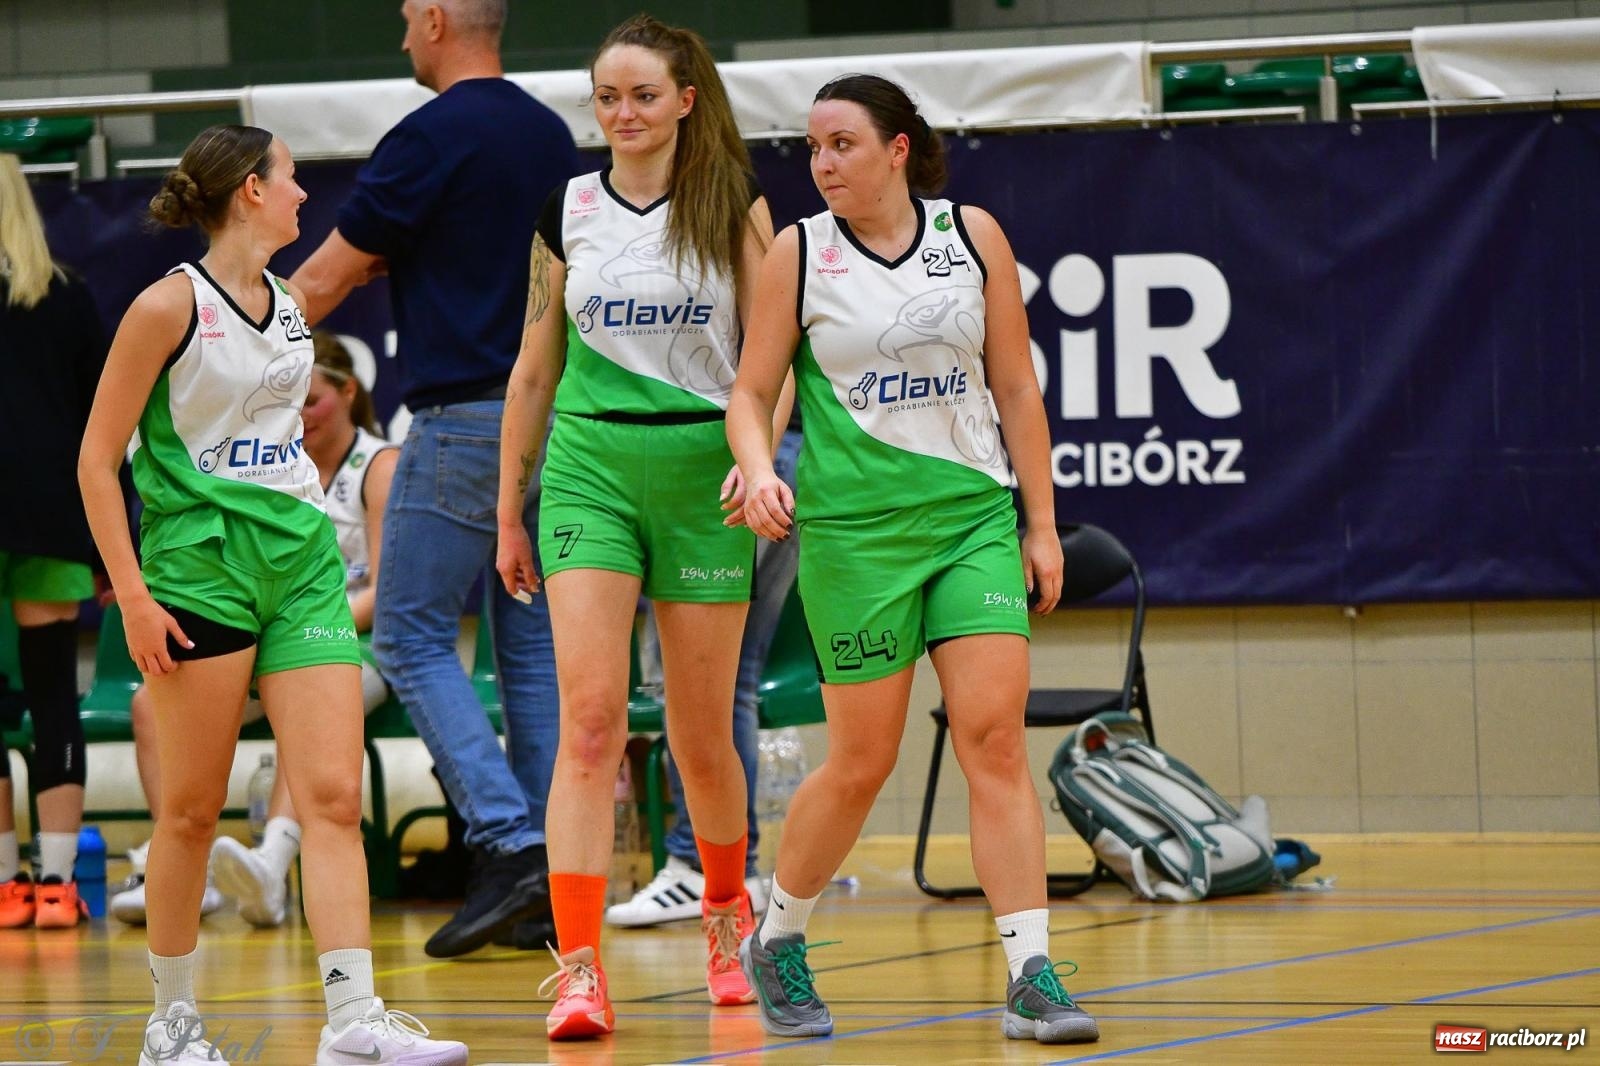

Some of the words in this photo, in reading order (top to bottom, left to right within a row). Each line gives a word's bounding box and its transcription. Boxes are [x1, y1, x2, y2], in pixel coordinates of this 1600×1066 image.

[922, 244, 970, 278] 24
[603, 297, 713, 327] Clavis
[879, 367, 967, 404] Clavis
[888, 400, 941, 413] DORABIANIE
[1051, 425, 1246, 488] CIBÓRZ
[554, 523, 583, 559] 7
[831, 629, 897, 671] 24
